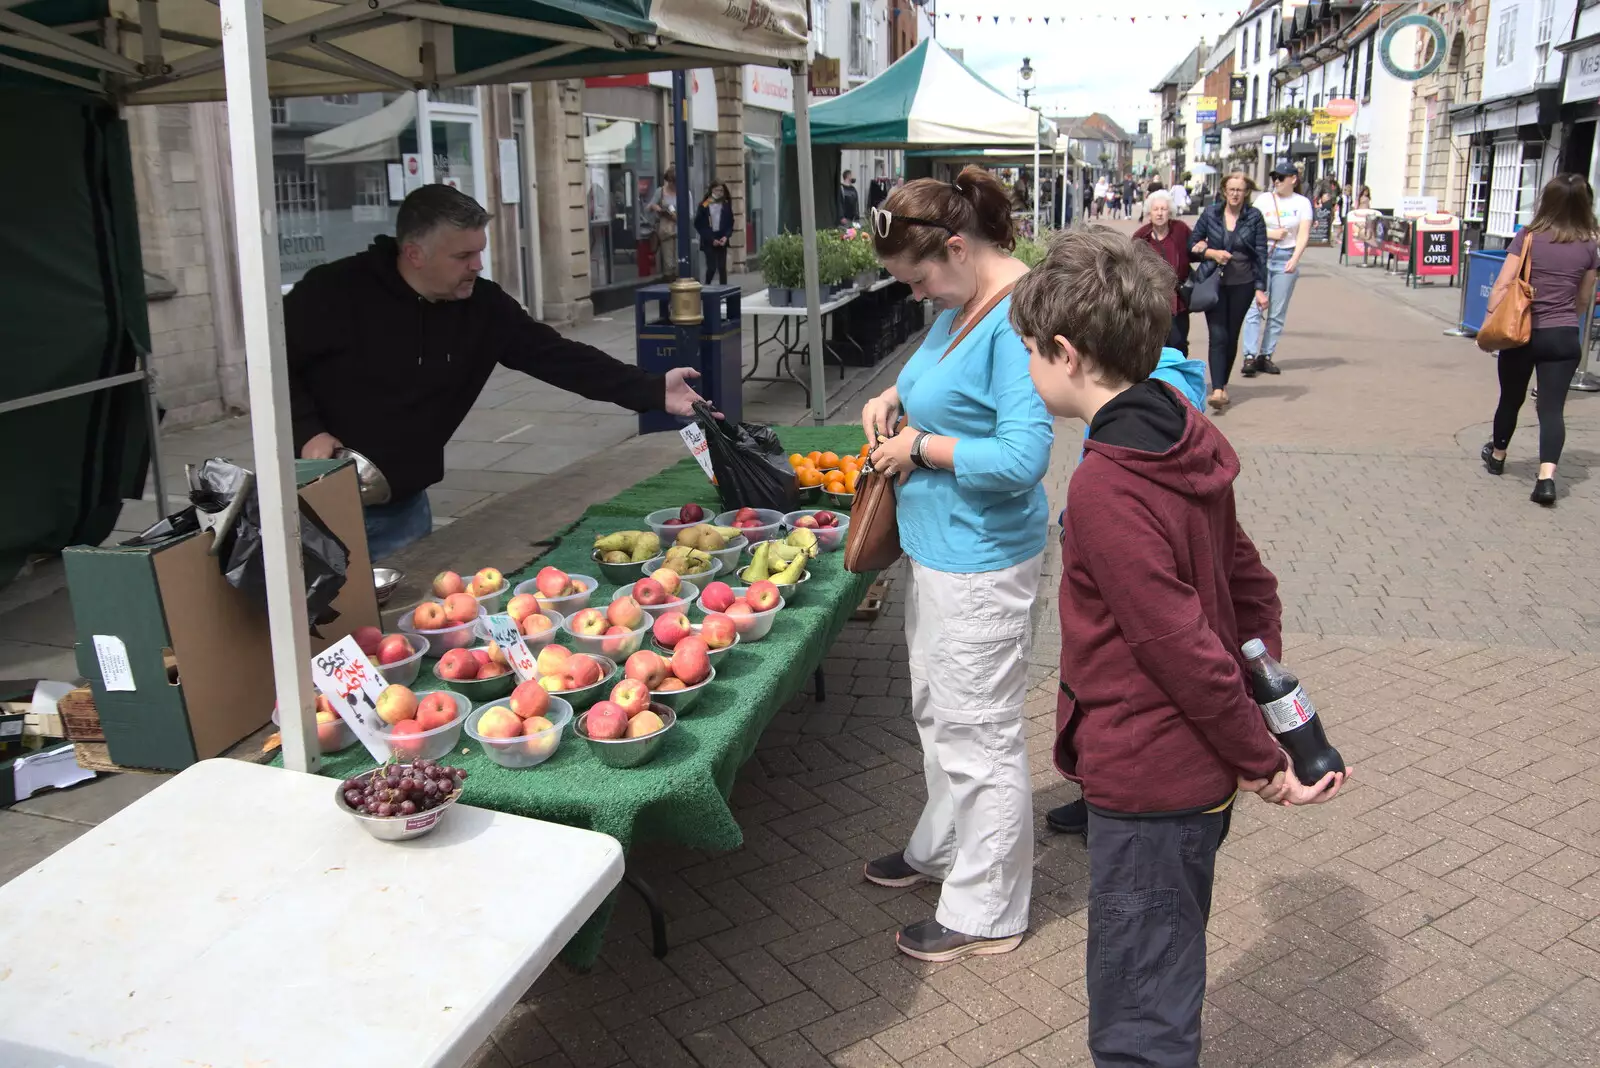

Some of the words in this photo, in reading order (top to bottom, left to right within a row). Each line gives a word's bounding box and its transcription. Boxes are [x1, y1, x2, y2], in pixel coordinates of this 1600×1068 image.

[815, 87, 838, 95] EWM
[1430, 233, 1446, 242] WE
[1427, 244, 1447, 253] ARE
[1423, 255, 1451, 264] OPEN
[316, 647, 350, 678] BEST
[334, 658, 364, 683] PINK
